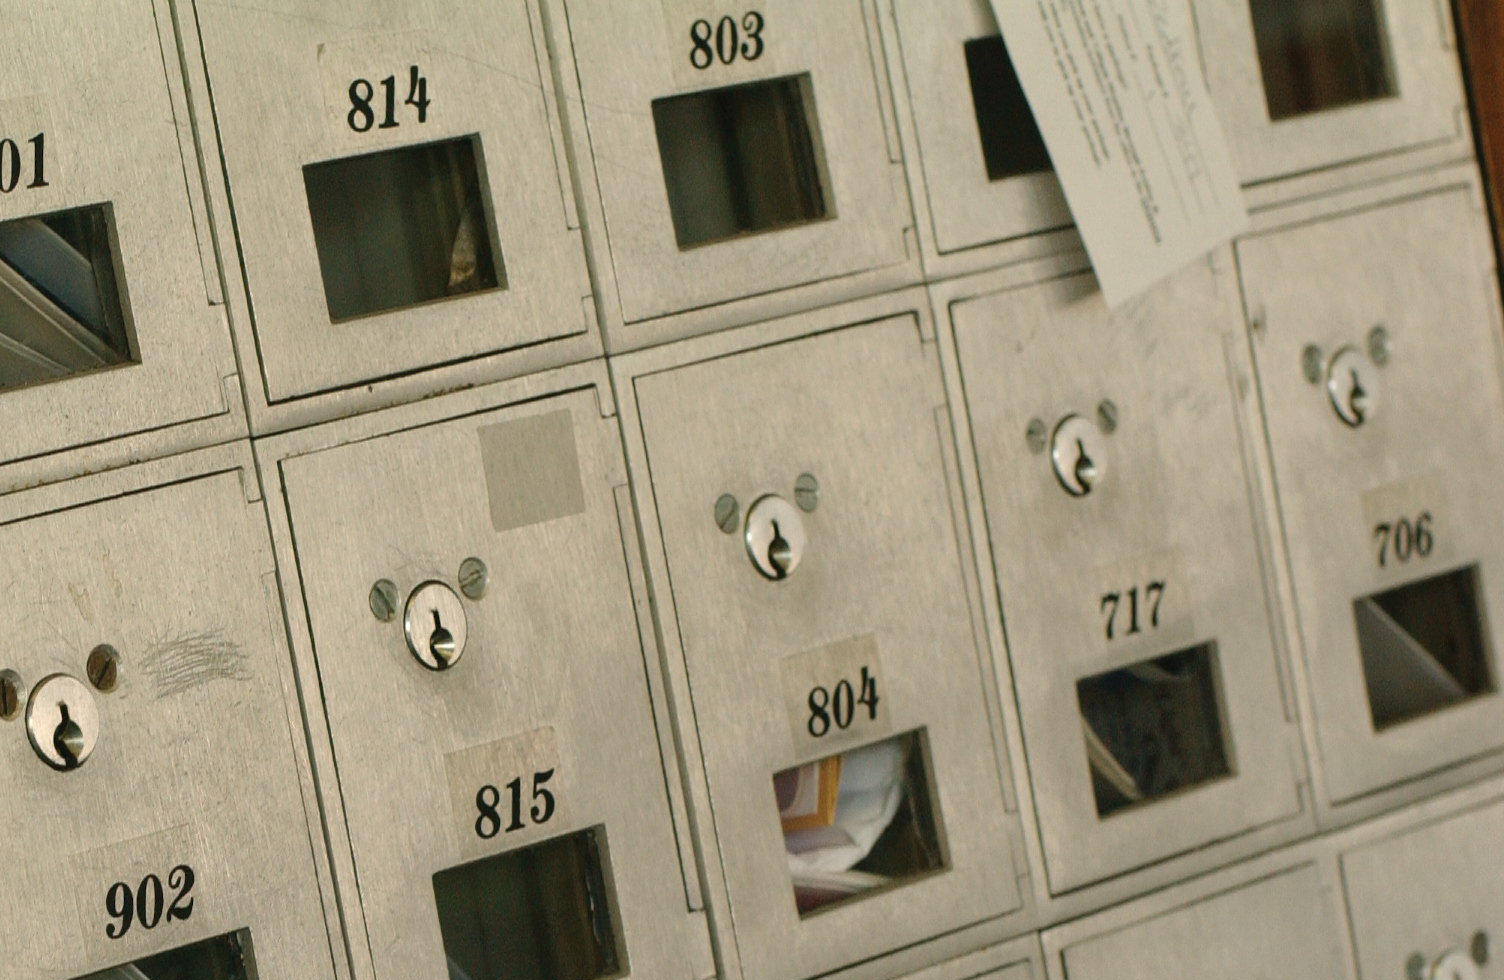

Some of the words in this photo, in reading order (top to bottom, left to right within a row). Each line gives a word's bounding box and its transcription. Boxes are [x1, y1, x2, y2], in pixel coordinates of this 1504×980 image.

[690, 11, 764, 69] 803
[348, 66, 430, 132] 814
[1374, 512, 1434, 568] 706
[1102, 582, 1164, 640] 717
[808, 667, 879, 737] 804
[475, 769, 555, 839] 815
[106, 865, 195, 939] 902
